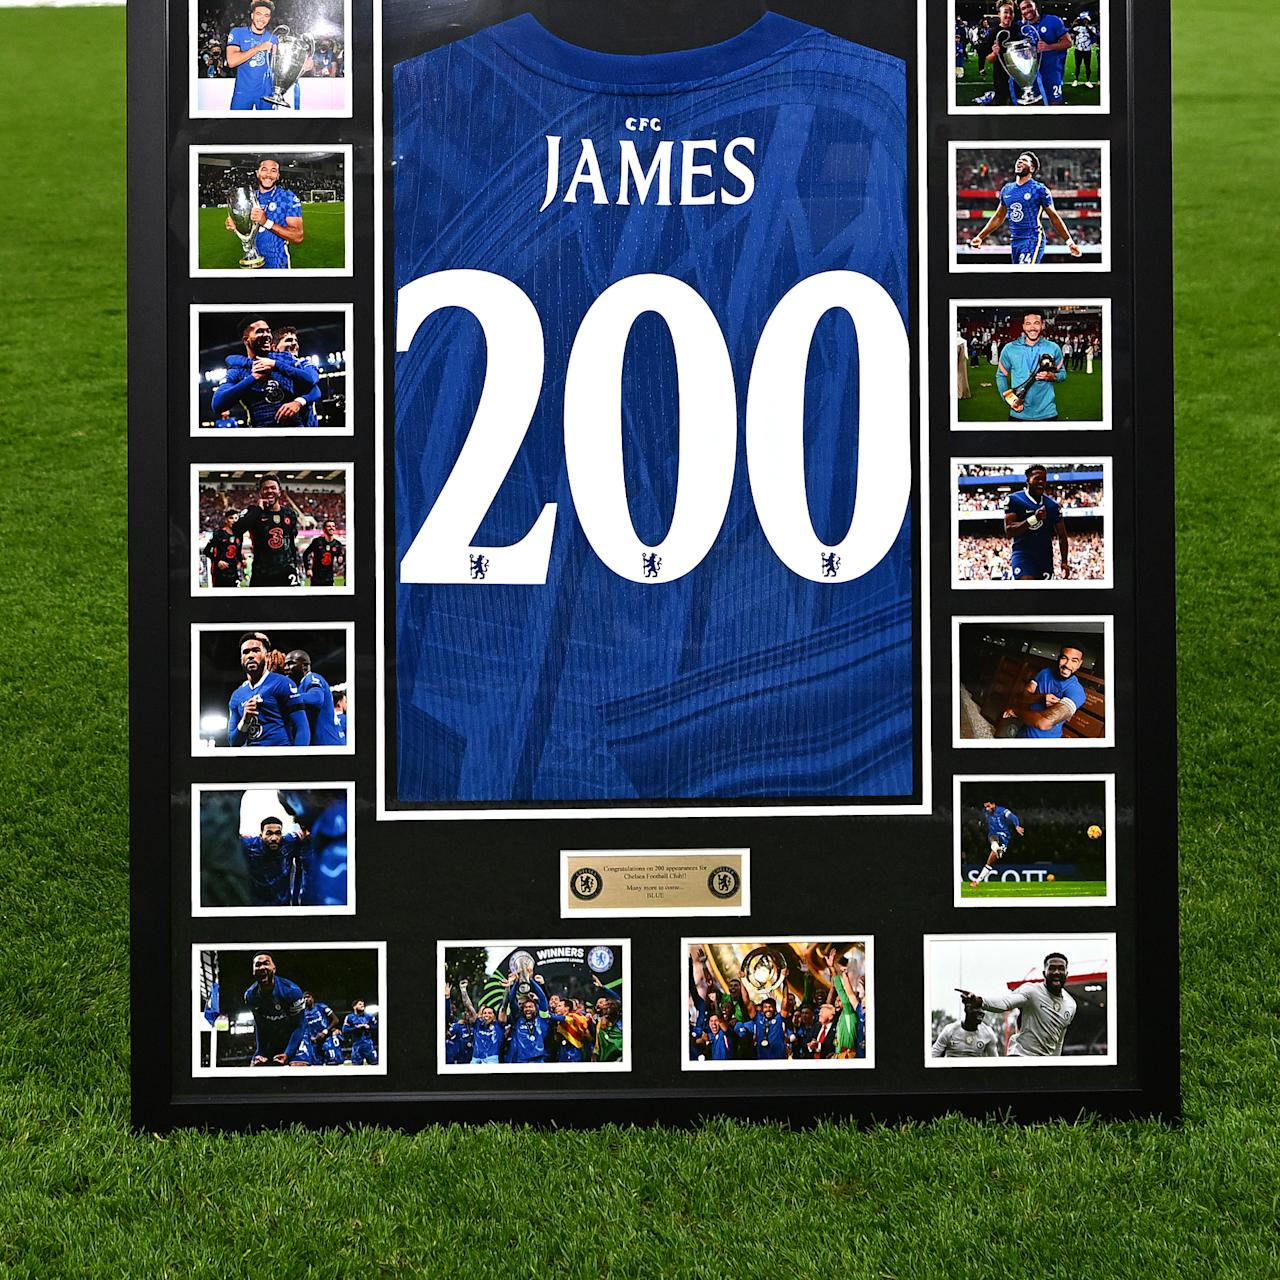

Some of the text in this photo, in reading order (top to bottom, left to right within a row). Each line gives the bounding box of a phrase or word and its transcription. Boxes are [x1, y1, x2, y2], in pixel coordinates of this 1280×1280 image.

[625, 116, 662, 132] CFC
[539, 134, 757, 213] JAMES
[396, 268, 912, 585] 200
[603, 865, 646, 873] Congratulations
[665, 865, 699, 873] appearances
[536, 947, 585, 960] WINNERS
